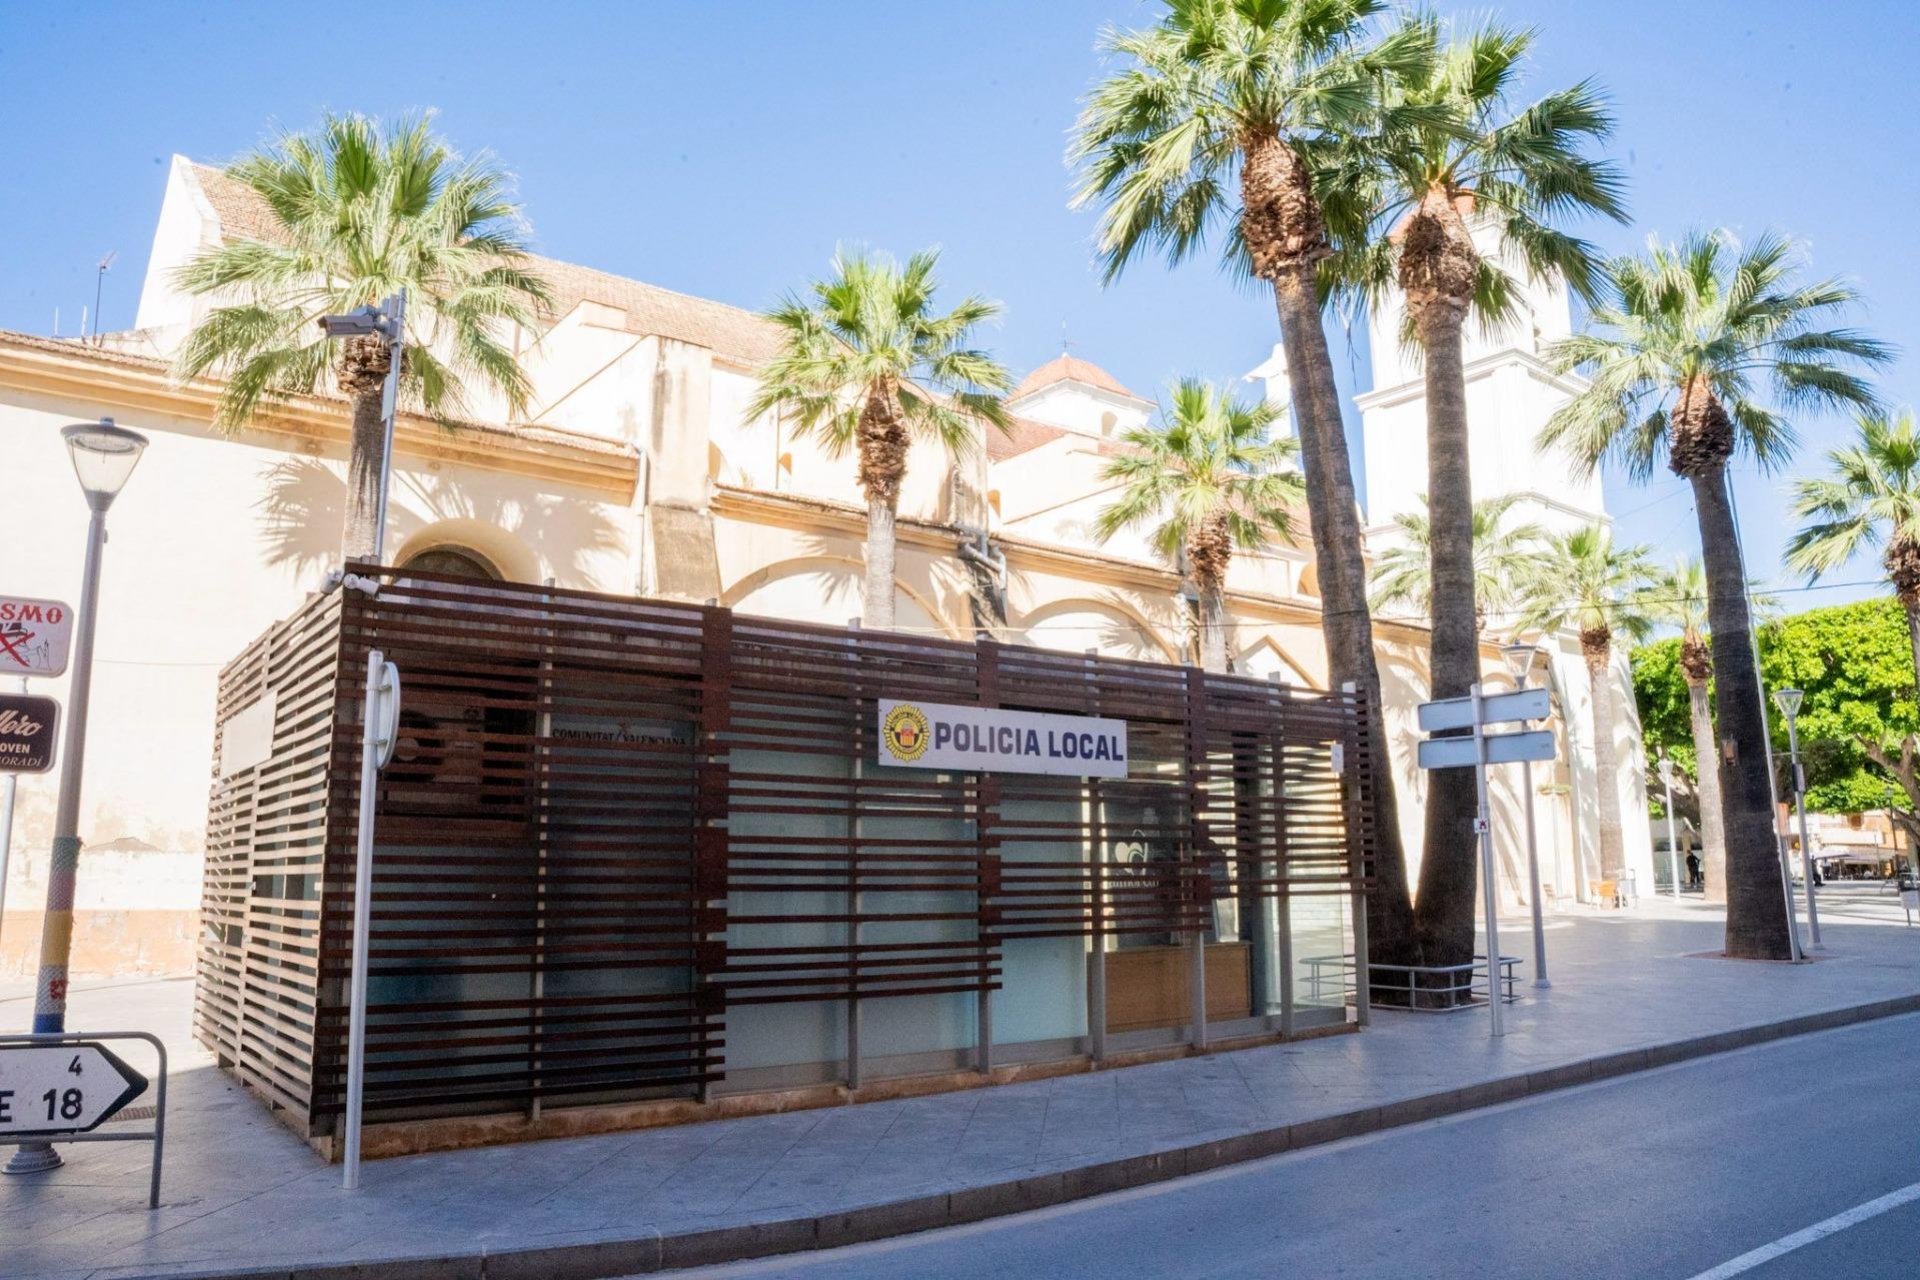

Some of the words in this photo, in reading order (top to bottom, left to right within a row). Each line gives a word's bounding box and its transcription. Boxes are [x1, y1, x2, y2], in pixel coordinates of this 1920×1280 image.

[1, 604, 62, 624] SMO
[0, 743, 31, 754] OVEN
[935, 722, 1041, 756] POLICIA
[1049, 731, 1123, 761] LOCAL
[0, 756, 42, 767] ORADÍ
[68, 1055, 83, 1076] 4
[0, 1090, 15, 1122] E
[43, 1088, 83, 1121] 18
